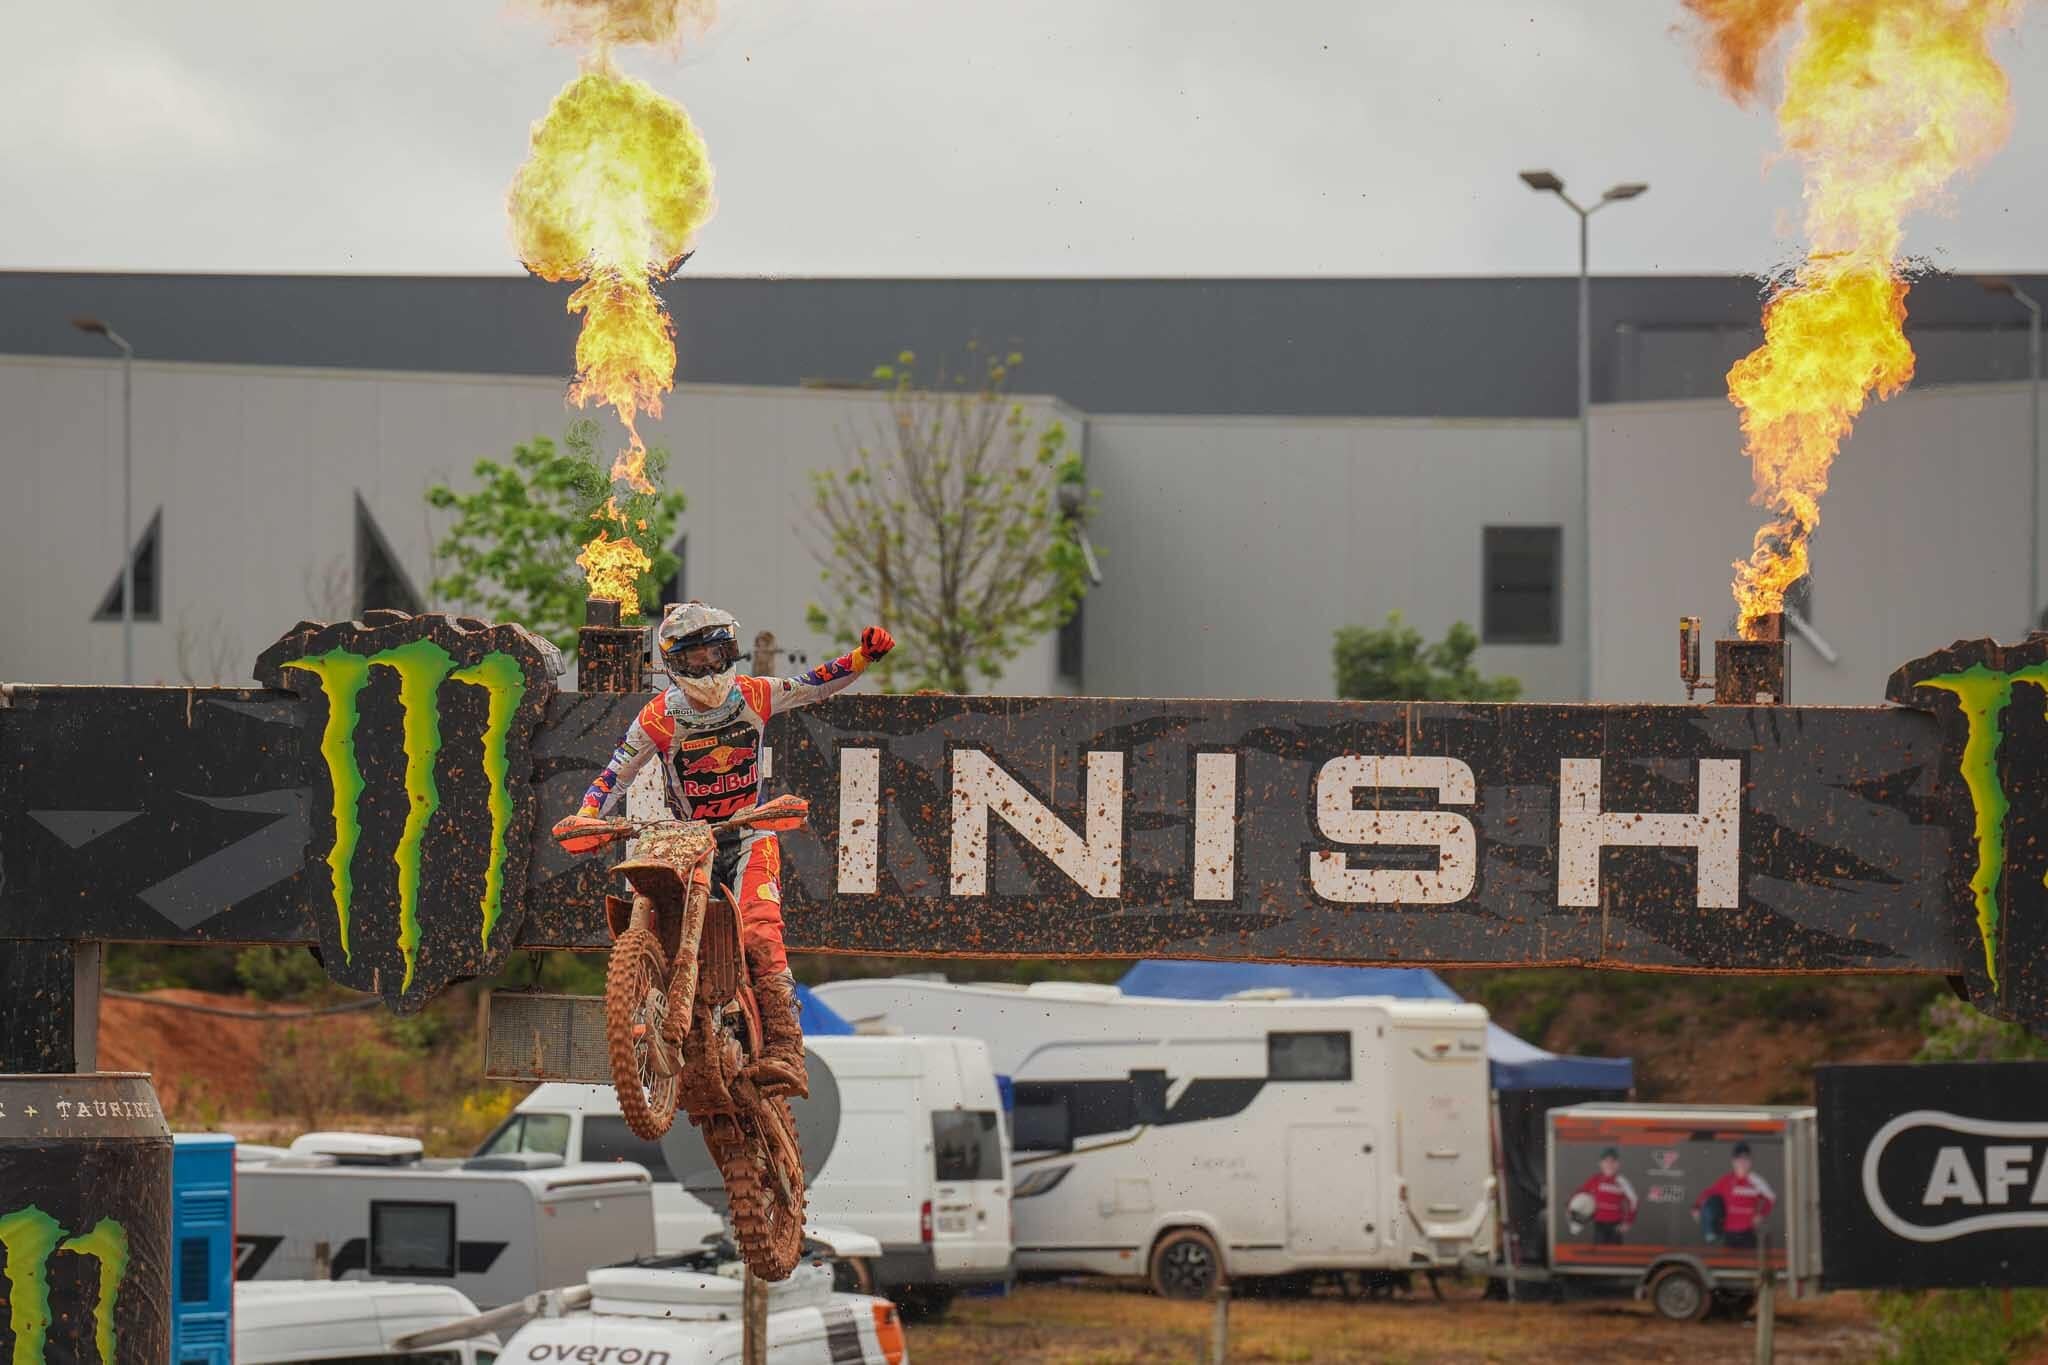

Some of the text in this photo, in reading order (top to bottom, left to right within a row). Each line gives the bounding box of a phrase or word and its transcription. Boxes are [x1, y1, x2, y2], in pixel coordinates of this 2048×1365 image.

[684, 775, 724, 797] Red
[626, 746, 1741, 909] INISH
[56, 1100, 154, 1120] TAURINE
[528, 1343, 671, 1365] overon
